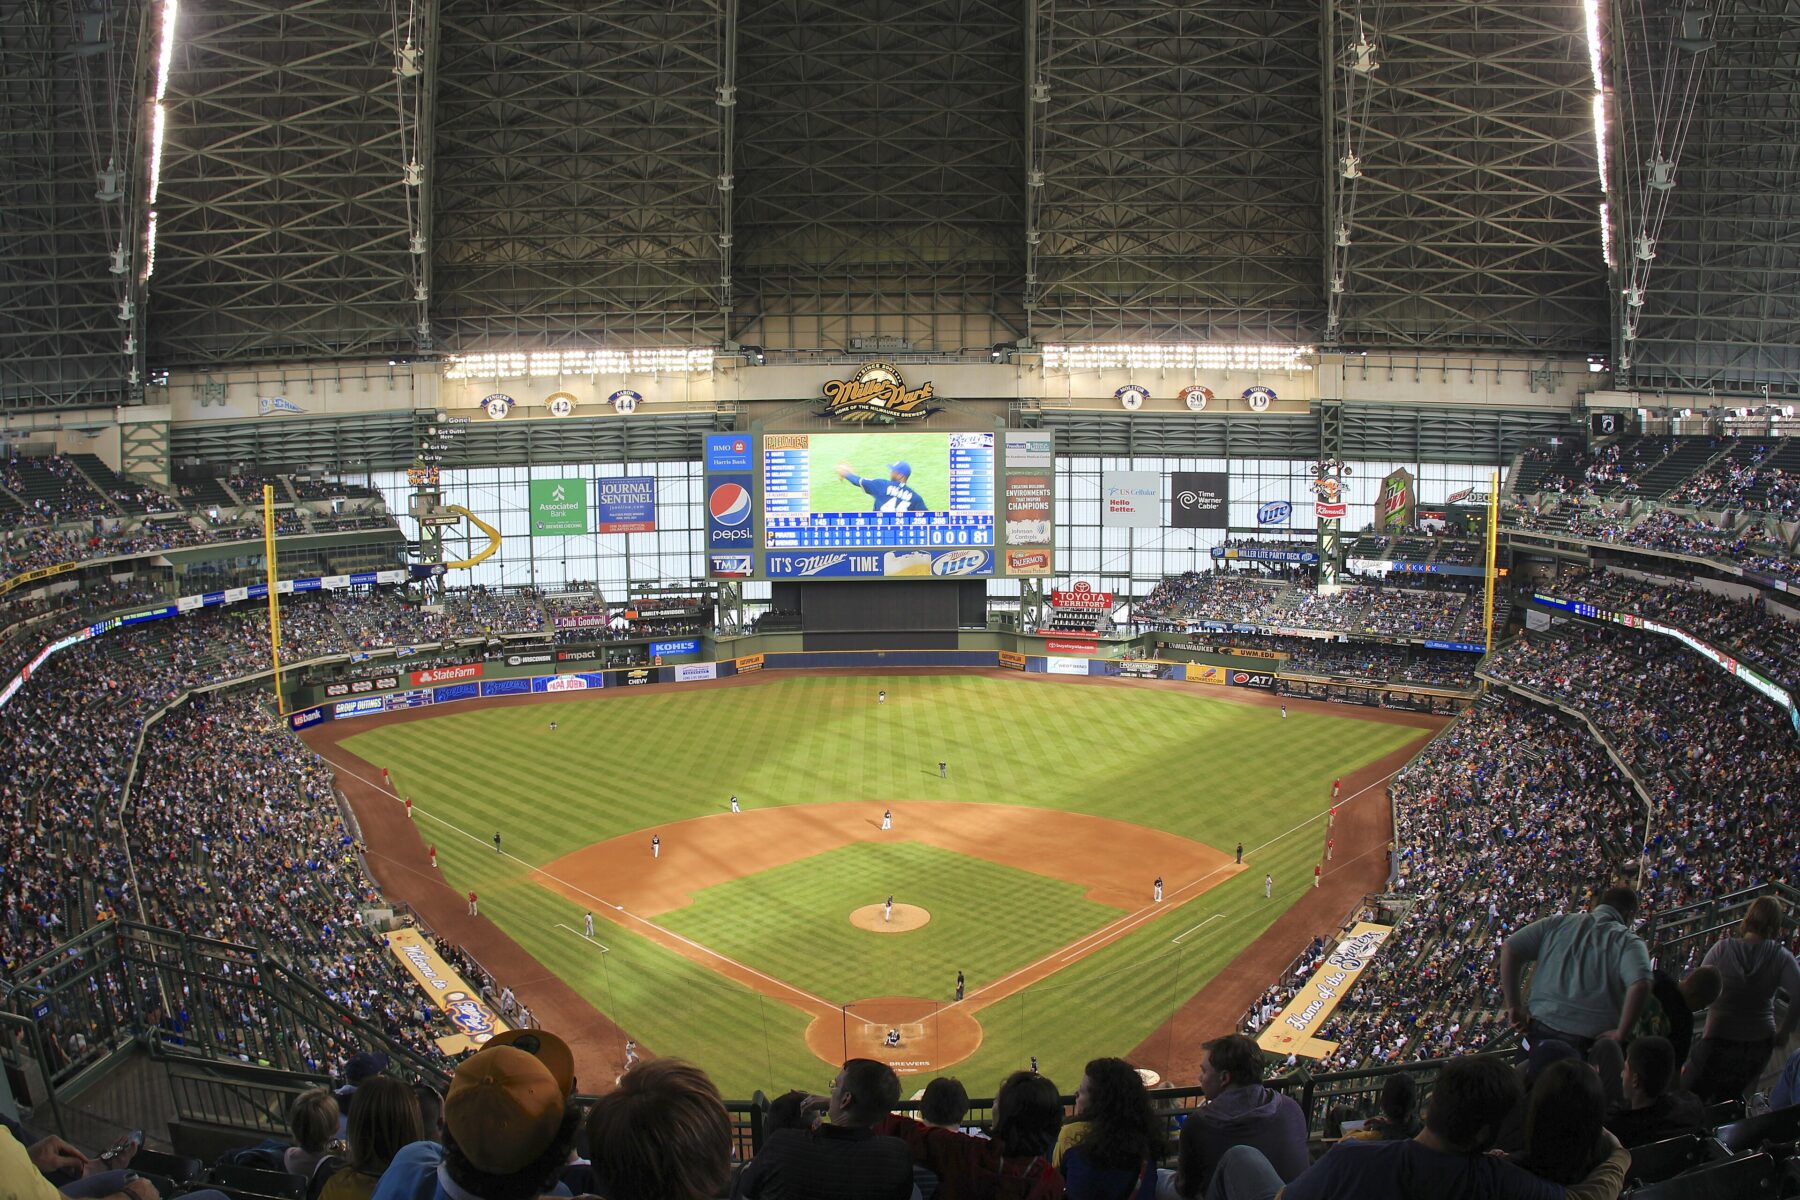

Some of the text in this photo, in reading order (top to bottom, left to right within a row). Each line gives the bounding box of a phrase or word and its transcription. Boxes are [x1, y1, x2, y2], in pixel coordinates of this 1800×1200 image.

[861, 364, 895, 374] SINCE 2001
[824, 379, 933, 409] Miller Park
[1191, 394, 1202, 403] 50
[618, 400, 632, 410] 44
[1128, 395, 1134, 405] 4
[1253, 396, 1266, 407] 19
[490, 404, 505, 415] 34
[554, 402, 569, 412] 42
[835, 407, 849, 415] HOME
[870, 406, 900, 417] MILWAUKEE
[601, 483, 652, 495] JOURNAL
[601, 494, 652, 504] SENTINEL
[540, 502, 578, 510] Associated
[1262, 505, 1287, 523] Lite
[712, 528, 750, 541] pepsi
[933, 531, 988, 544] 0 0 0 81
[950, 551, 970, 560] Miller
[1239, 549, 1256, 557] MILLER
[1257, 550, 1268, 558] LITE
[1269, 550, 1285, 559] PARTY
[1287, 552, 1300, 560] DECK
[771, 552, 881, 575] IT'S Miller TIME
[941, 554, 980, 575] Lite
[1059, 593, 1104, 601] TOYOTA
[562, 615, 605, 627] Club Goodwill
[656, 643, 694, 651] KOHL'S
[566, 650, 596, 660] impact
[1240, 650, 1275, 658] UWM.EDU
[549, 681, 565, 690] PAPA
[1248, 676, 1273, 685] ATI
[336, 702, 356, 712] GROUP
[358, 698, 381, 710] OUTINGS
[401, 944, 438, 978] Welcome
[1286, 931, 1387, 1031] Home of the Brewers
